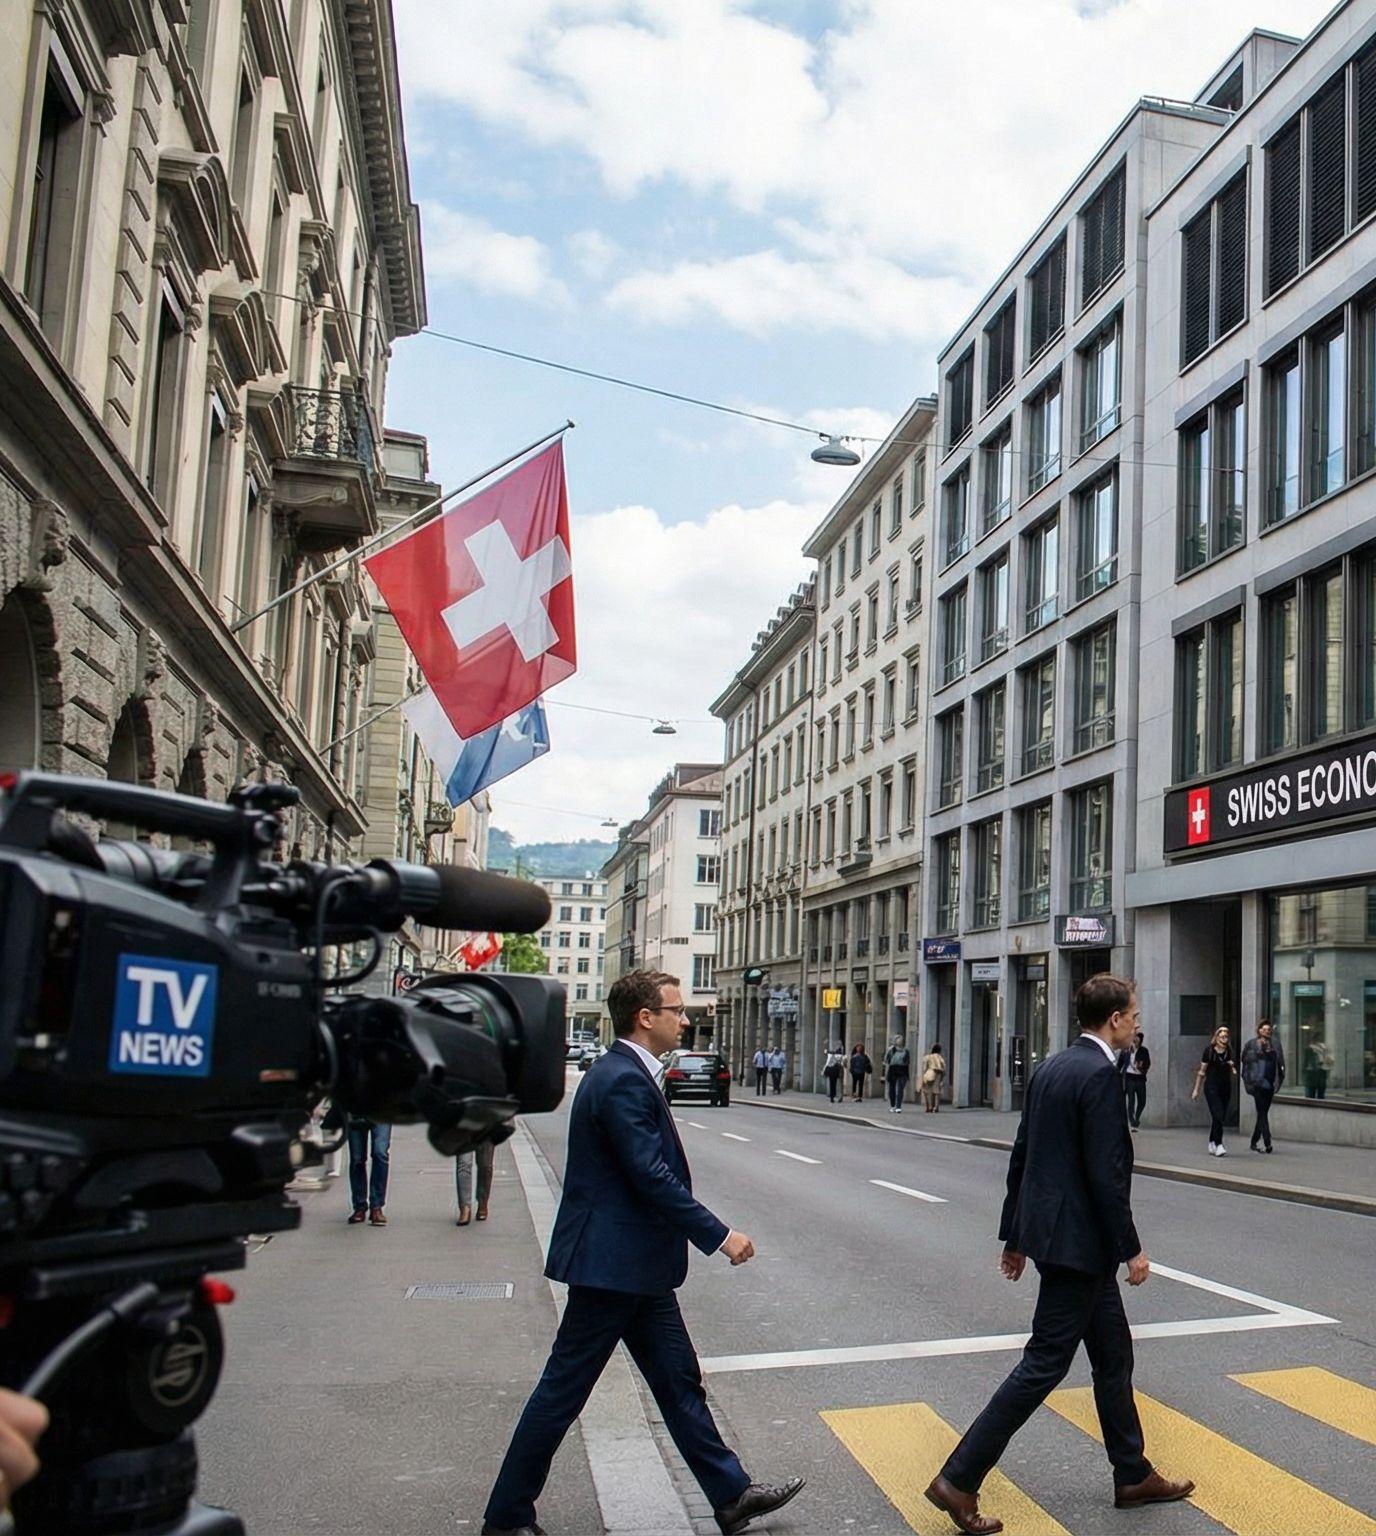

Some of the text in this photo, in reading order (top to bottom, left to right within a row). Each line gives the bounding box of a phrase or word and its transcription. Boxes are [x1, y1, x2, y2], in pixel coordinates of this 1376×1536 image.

[1227, 774, 1291, 828] SWISS
[126, 966, 209, 1029] TV
[118, 1030, 204, 1067] NEWS
